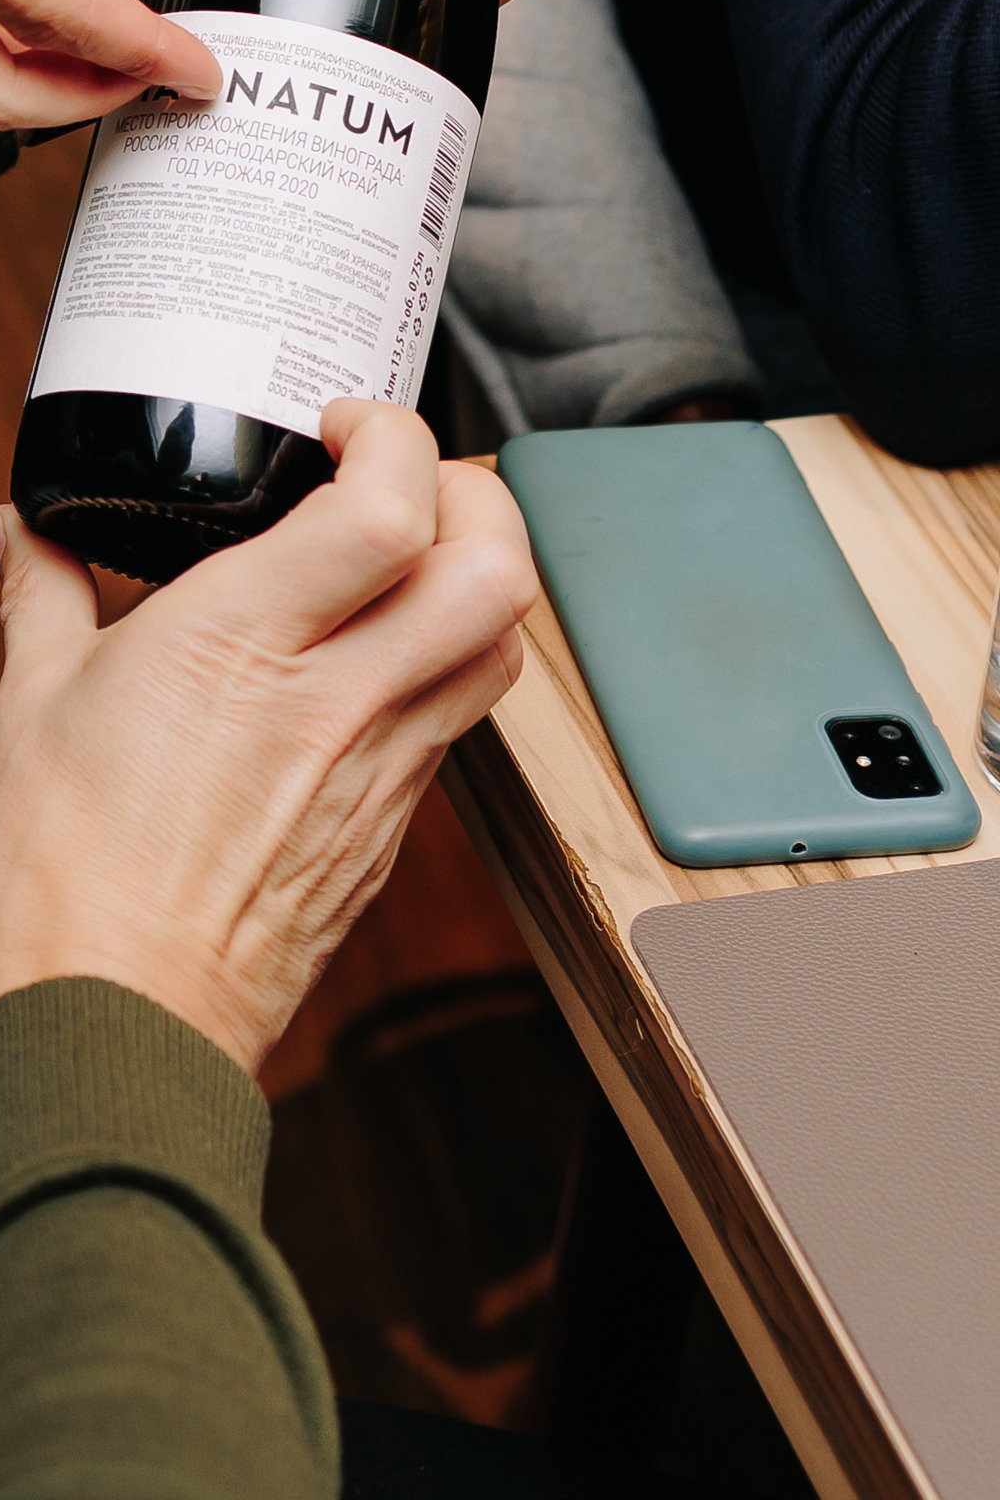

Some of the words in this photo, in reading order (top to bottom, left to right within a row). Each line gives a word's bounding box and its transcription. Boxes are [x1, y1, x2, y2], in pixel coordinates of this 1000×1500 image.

[209, 33, 286, 51] ЗАЩИЩЕННЫМ
[289, 45, 382, 80] ГЕОГРАФИЧЕСКИМ
[384, 74, 433, 104] УКАЗАНИЕМ
[223, 46, 256, 59] СУХОЕ
[257, 50, 292, 65] БЕЛОЕ
[301, 59, 357, 83] МАГНАТУМ
[359, 77, 404, 103] ШАРДОНЕ
[140, 67, 415, 156] NATUM
[114, 113, 155, 134] МЕСТО
[157, 111, 307, 147] ПРОИСХОЖДЕНИЯ
[311, 136, 405, 186] ВИНОГРАДА:
[124, 135, 179, 153] РОССИЯ,
[185, 136, 333, 179] КРАСНОДАРСКИЙ
[337, 169, 378, 199] КРАЙ.
[167, 157, 199, 178] ГОД
[203, 160, 275, 187] УРОЖАЯ
[279, 174, 318, 199] 2020
[209, 195, 252, 208] температуре
[227, 208, 271, 222] температуре
[140, 209, 152, 219] НЕ
[153, 209, 207, 223] ОГРАНИЧЕН
[209, 214, 231, 227] ПРИ
[233, 219, 304, 245] СОБЛЮДЕНИИ
[306, 238, 350, 262] УСЛОВИЙ
[151, 240, 184, 251] ОРГАНОВ
[175, 224, 204, 234] ДЕТЯМ
[221, 230, 277, 248] ПОДРОСТКАМ
[281, 244, 295, 254] ДО
[151, 231, 179, 240] ЛИЦАМ
[188, 235, 259, 254] ЗАБОЛЕВАНИЯМИ
[261, 249, 320, 272] ЦЕНТРАЛЬНОЙ
[321, 267, 355, 286] НЕРВНОЙ
[408, 251, 425, 292] 0,75л
[173, 264, 192, 273] ГОСТ
[259, 279, 268, 288] ТР
[275, 283, 284, 293] ТС
[404, 297, 415, 318] об.
[399, 320, 409, 335] %
[391, 335, 405, 367] 13,5
[268, 382, 288, 397] ООО
[384, 370, 398, 400] Алк
